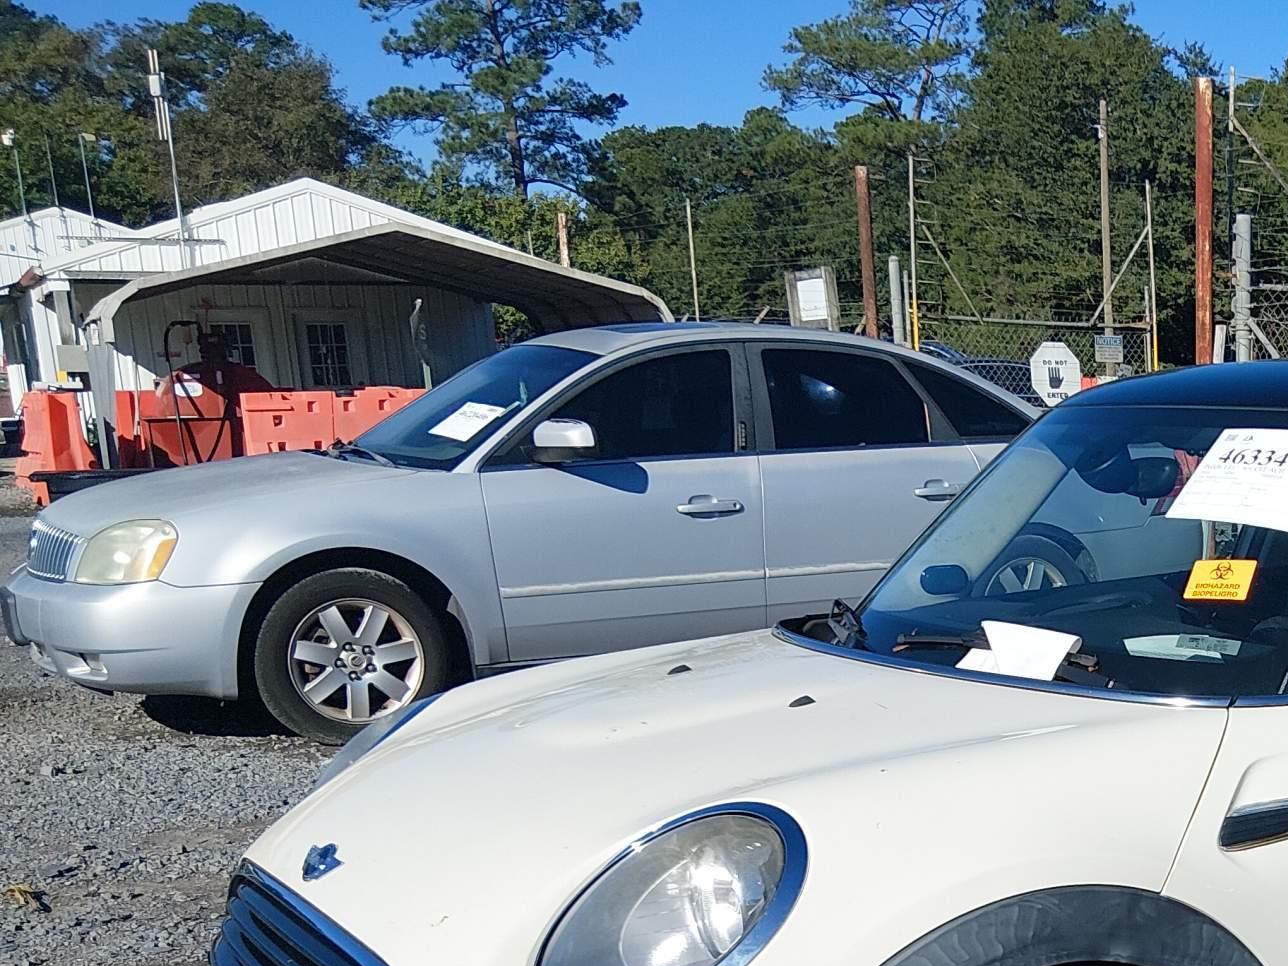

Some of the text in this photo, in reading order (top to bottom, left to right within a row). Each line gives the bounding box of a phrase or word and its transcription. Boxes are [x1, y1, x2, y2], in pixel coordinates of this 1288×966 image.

[1096, 336, 1122, 346] NOTICE
[1047, 392, 1069, 400] ENTER
[1191, 590, 1239, 598] BIOPELIGRO
